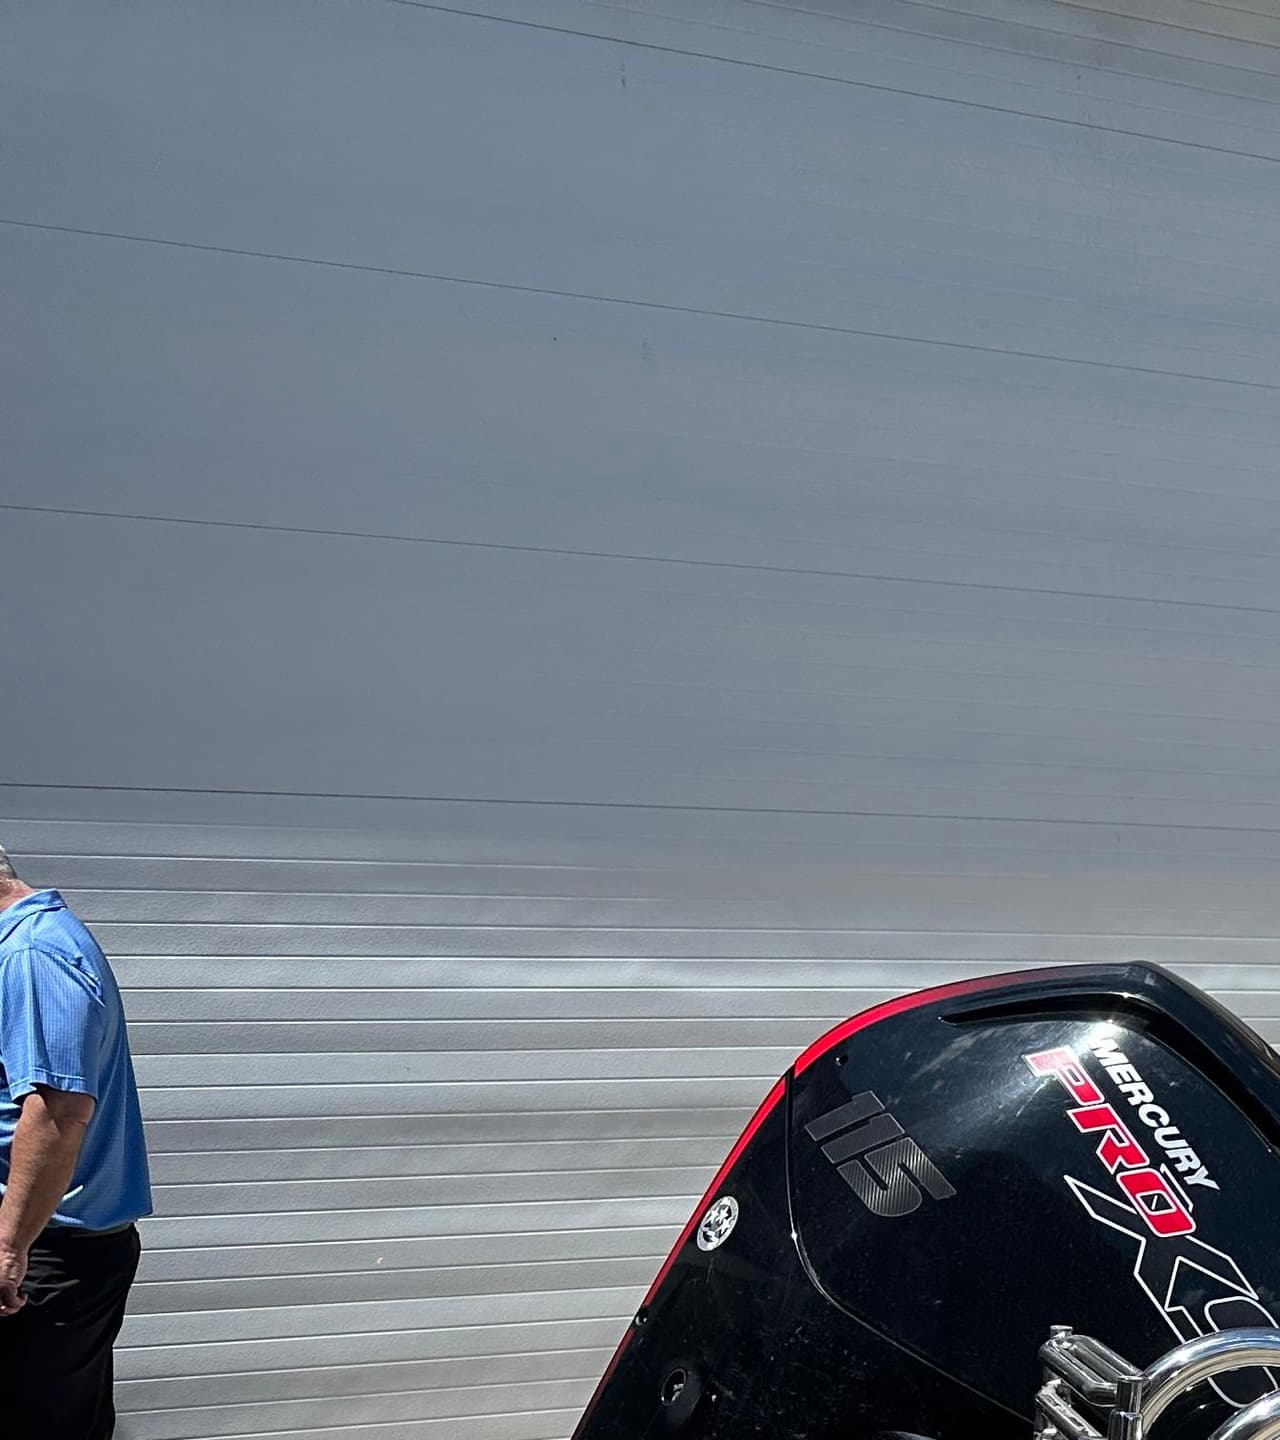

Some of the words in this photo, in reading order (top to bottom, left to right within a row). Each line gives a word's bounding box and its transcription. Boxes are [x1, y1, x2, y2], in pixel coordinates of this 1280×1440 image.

[804, 1090, 957, 1217] 115
[1024, 1046, 1197, 1238] PRO
[1090, 1035, 1220, 1192] MERCURY
